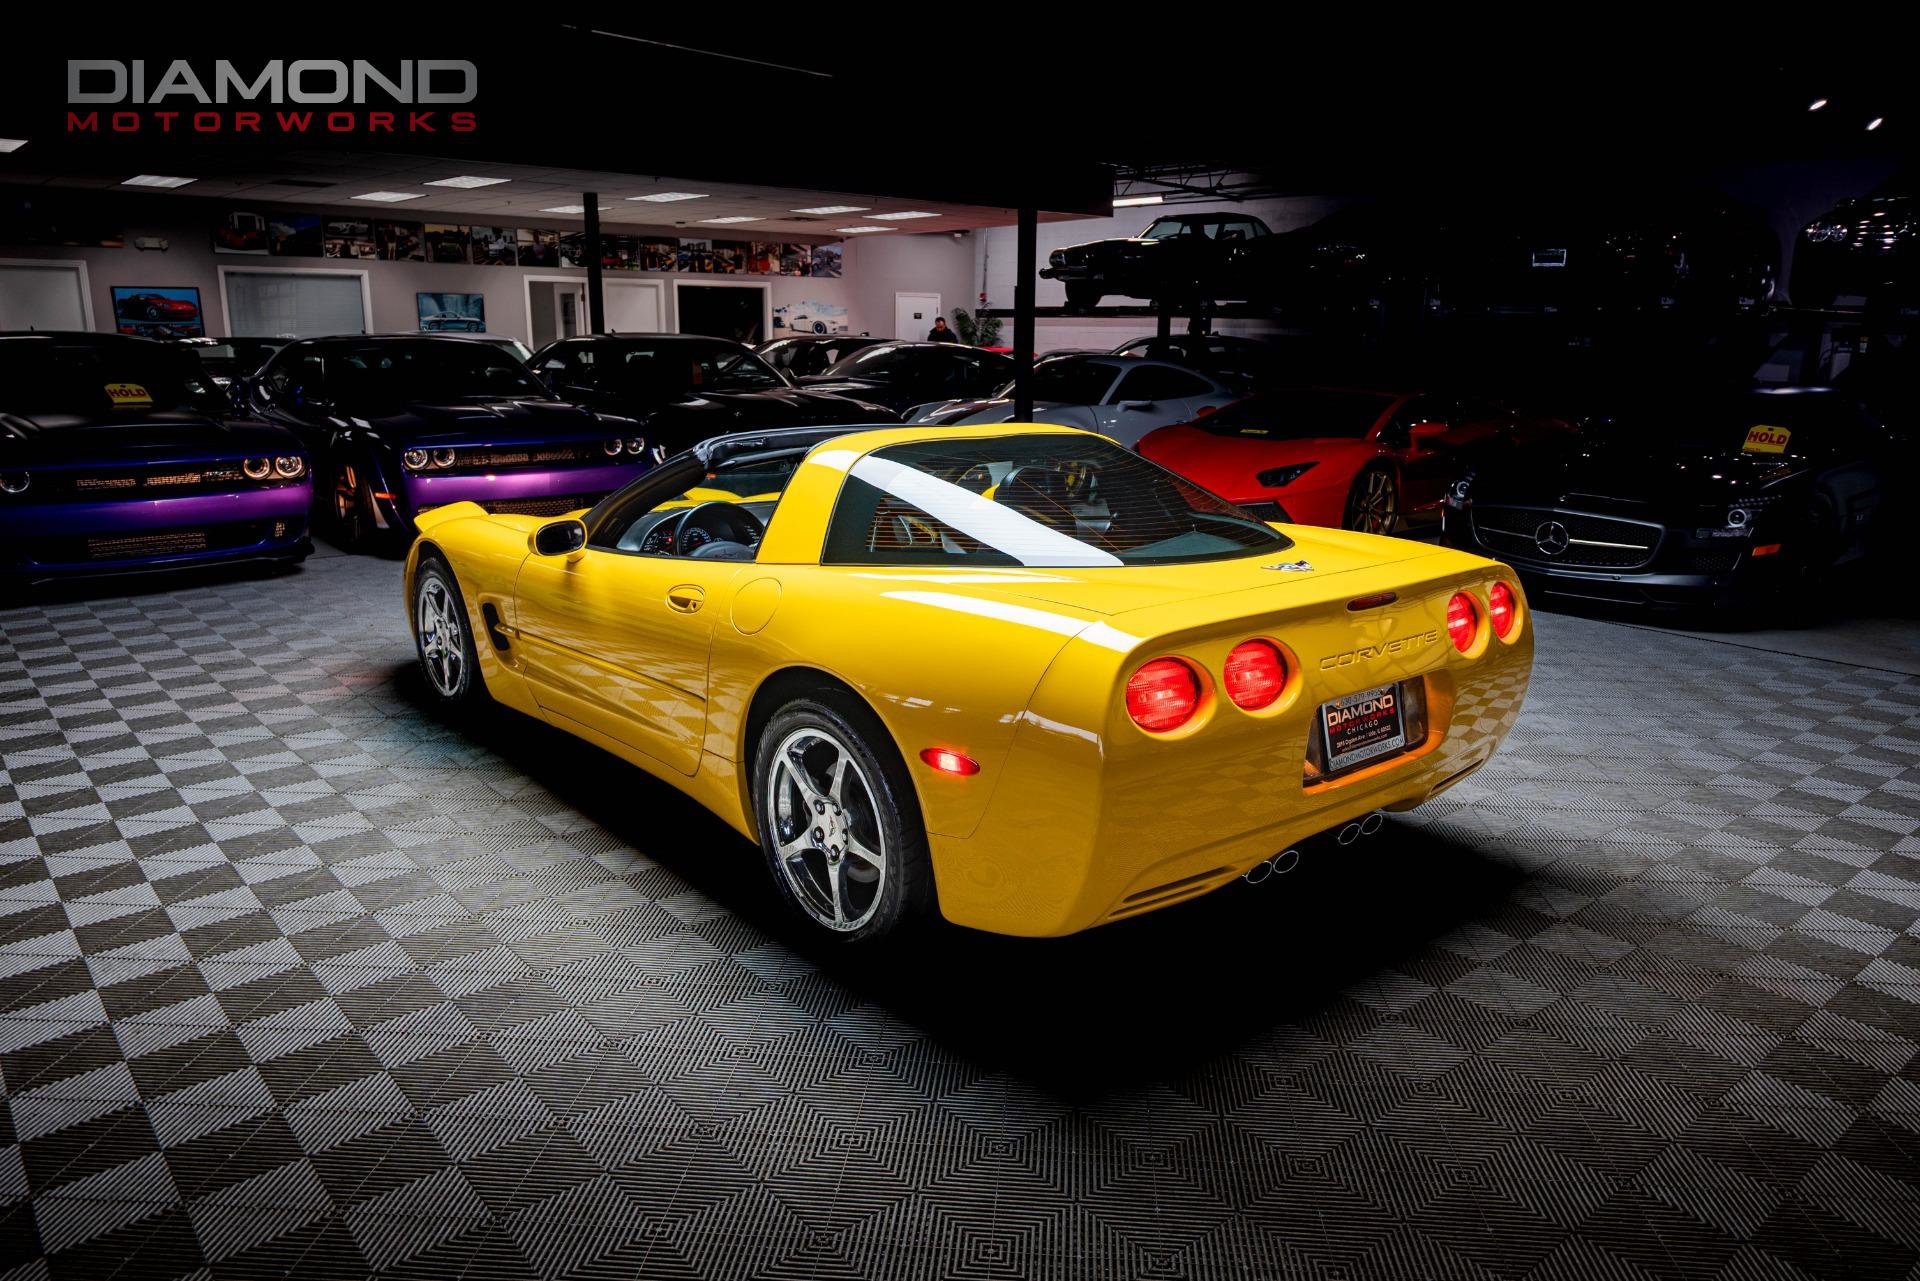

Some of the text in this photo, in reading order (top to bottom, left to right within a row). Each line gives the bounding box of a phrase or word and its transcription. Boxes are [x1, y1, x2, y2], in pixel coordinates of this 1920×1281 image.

[107, 388, 146, 397] HOLD
[1748, 431, 1787, 445] HOLD
[1320, 630, 1437, 671] CORVETTE
[1327, 695, 1394, 726] DIAMOND
[1329, 707, 1396, 734] MOTORWORKS
[1347, 720, 1379, 734] CHICAGO
